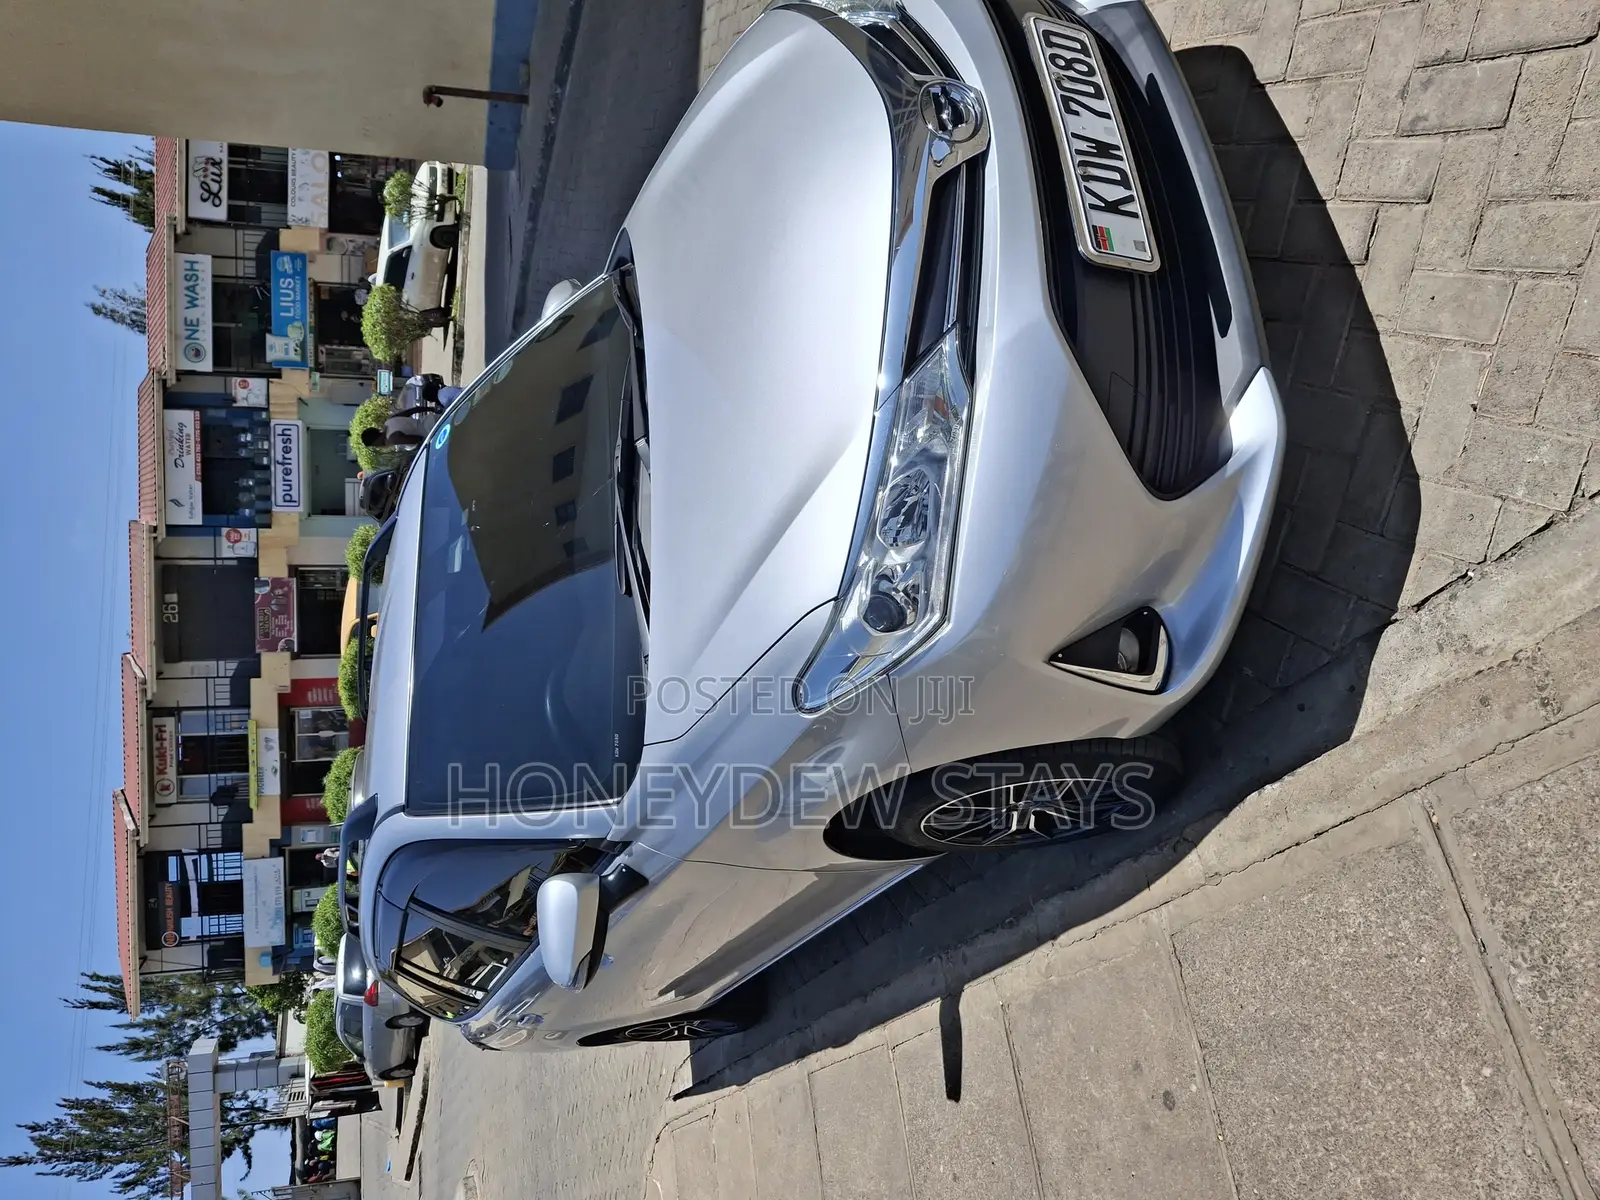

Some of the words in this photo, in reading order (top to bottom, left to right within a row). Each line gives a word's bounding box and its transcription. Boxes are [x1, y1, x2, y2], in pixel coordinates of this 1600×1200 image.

[1041, 29, 1112, 120] 708D
[200, 156, 222, 207] Lux
[1070, 132, 1140, 219] KDW
[184, 260, 199, 310] WASH
[280, 278, 294, 317] LIUS
[174, 422, 187, 468] Drinking
[276, 428, 297, 504] purefresh
[162, 604, 178, 623] 26
[154, 724, 168, 776] Kuki-Fri
[164, 882, 174, 906] BEAUTY
